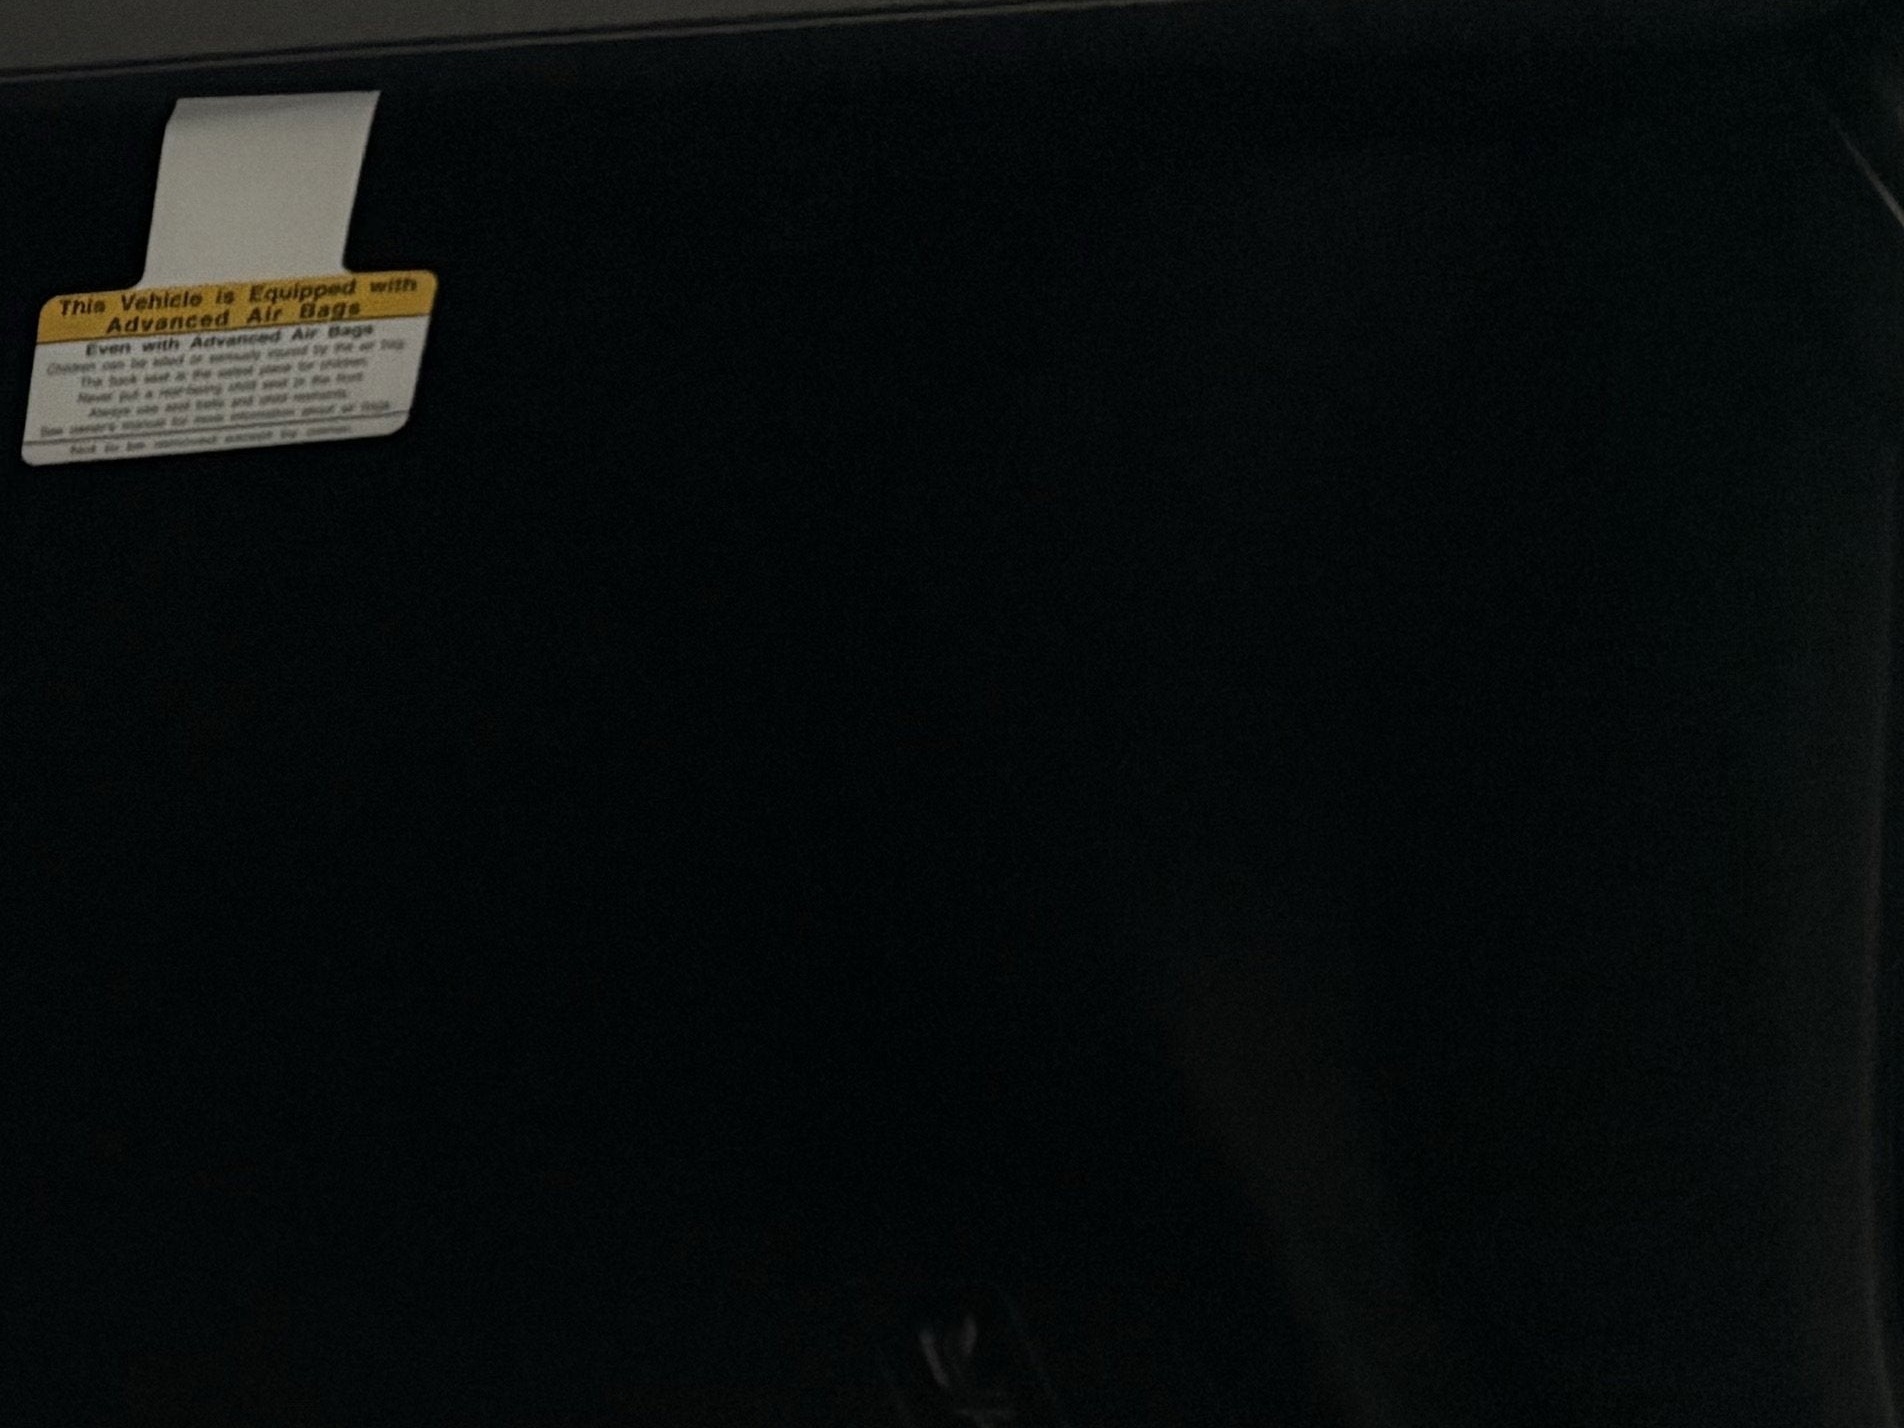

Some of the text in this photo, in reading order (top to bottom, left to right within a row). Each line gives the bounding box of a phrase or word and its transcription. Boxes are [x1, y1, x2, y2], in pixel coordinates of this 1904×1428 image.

[59, 278, 418, 316] This Vehicle is Equipped with
[106, 302, 361, 334] Advanced Air Bags
[86, 341, 131, 356] Even
[143, 337, 179, 353] with
[190, 329, 281, 349] Advanced
[292, 327, 319, 341] Air
